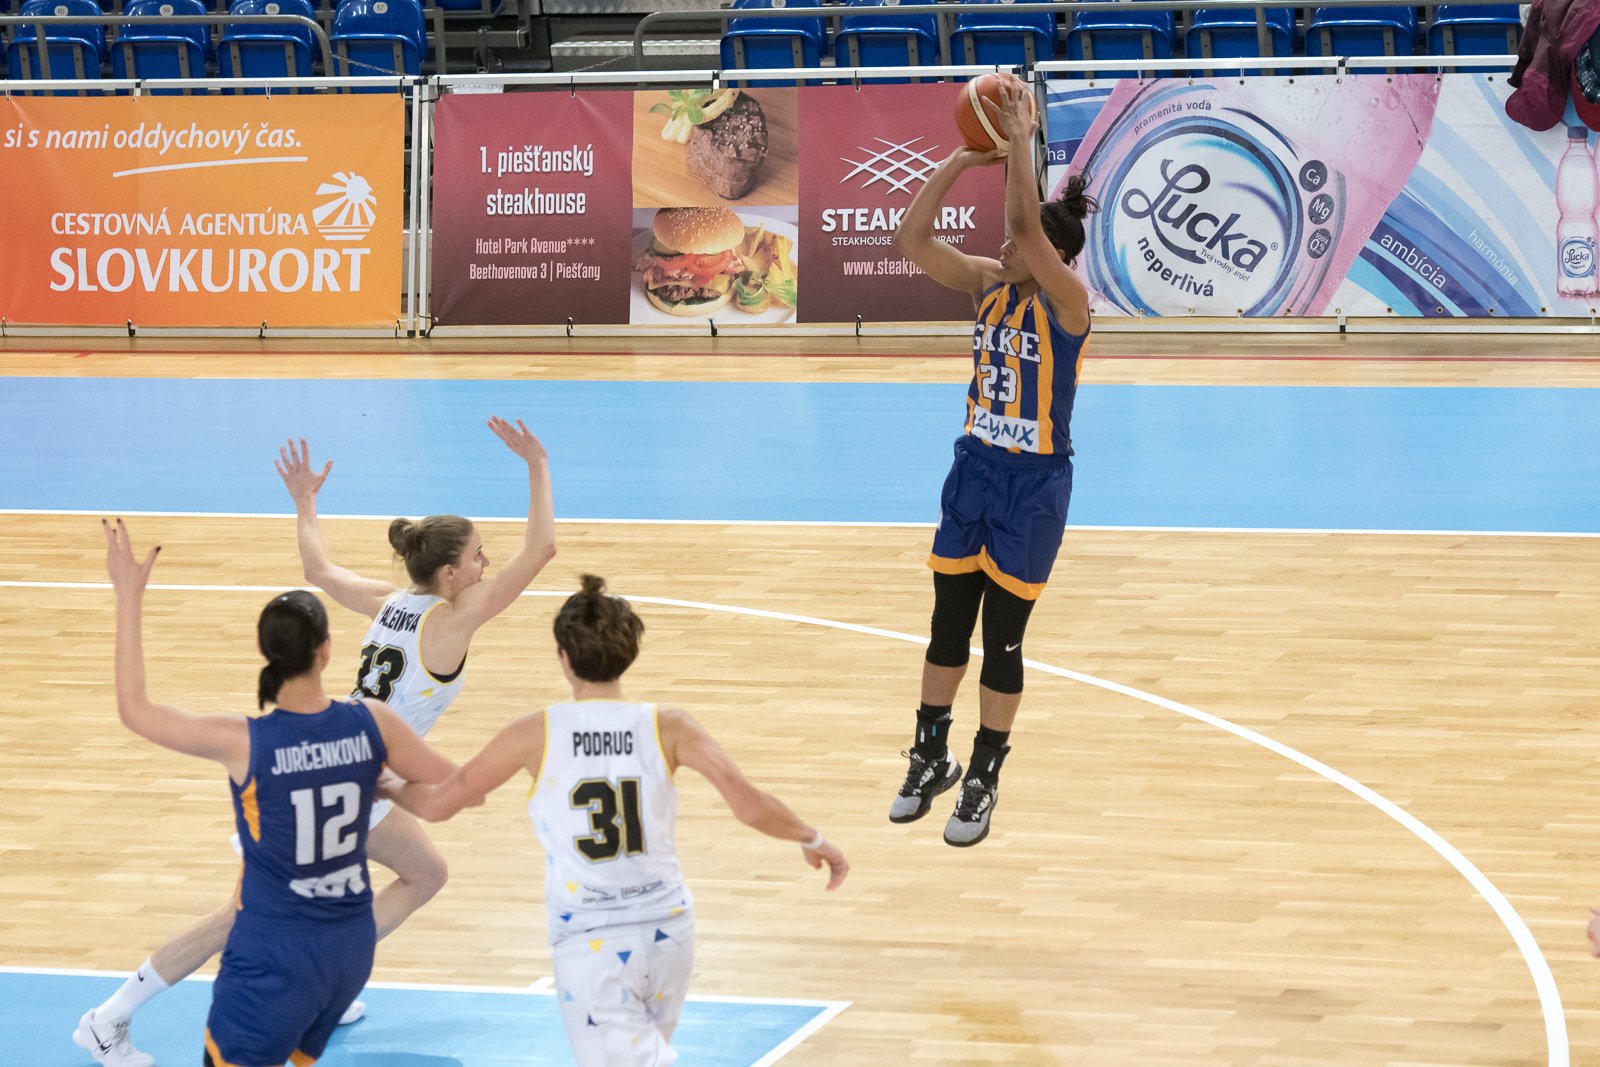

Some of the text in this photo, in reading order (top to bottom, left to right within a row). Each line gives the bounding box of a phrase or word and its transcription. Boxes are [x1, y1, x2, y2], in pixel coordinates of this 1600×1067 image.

[1134, 100, 1212, 135] pramenitá voda
[3, 121, 302, 156] si s nami oddychový čas.
[480, 143, 594, 178] 1. piešťanský
[1305, 168, 1321, 185] Ca
[486, 187, 586, 216] steakhouse
[1121, 158, 1268, 273] Lucka
[1312, 198, 1330, 219] Mg
[50, 206, 310, 236] CESTOVNÁ AGENTÚRA
[475, 238, 502, 254] Hotel
[504, 238, 528, 253] Park
[832, 236, 893, 247] STEAKHOUSE
[1468, 230, 1519, 286] harmónia
[1564, 248, 1590, 264] Lucka
[50, 246, 371, 293] SLOVKURORT
[469, 262, 601, 281] Beethovenova 3 Piešťany
[1137, 236, 1214, 297] neperlivá
[1380, 234, 1447, 289] ambícia
[979, 364, 1018, 404] 23
[975, 412, 1035, 447] LYNX
[271, 731, 373, 776] JURČENKOVÁ
[572, 730, 634, 758] PODRUG
[289, 780, 361, 866] 12
[568, 776, 648, 865] 31
